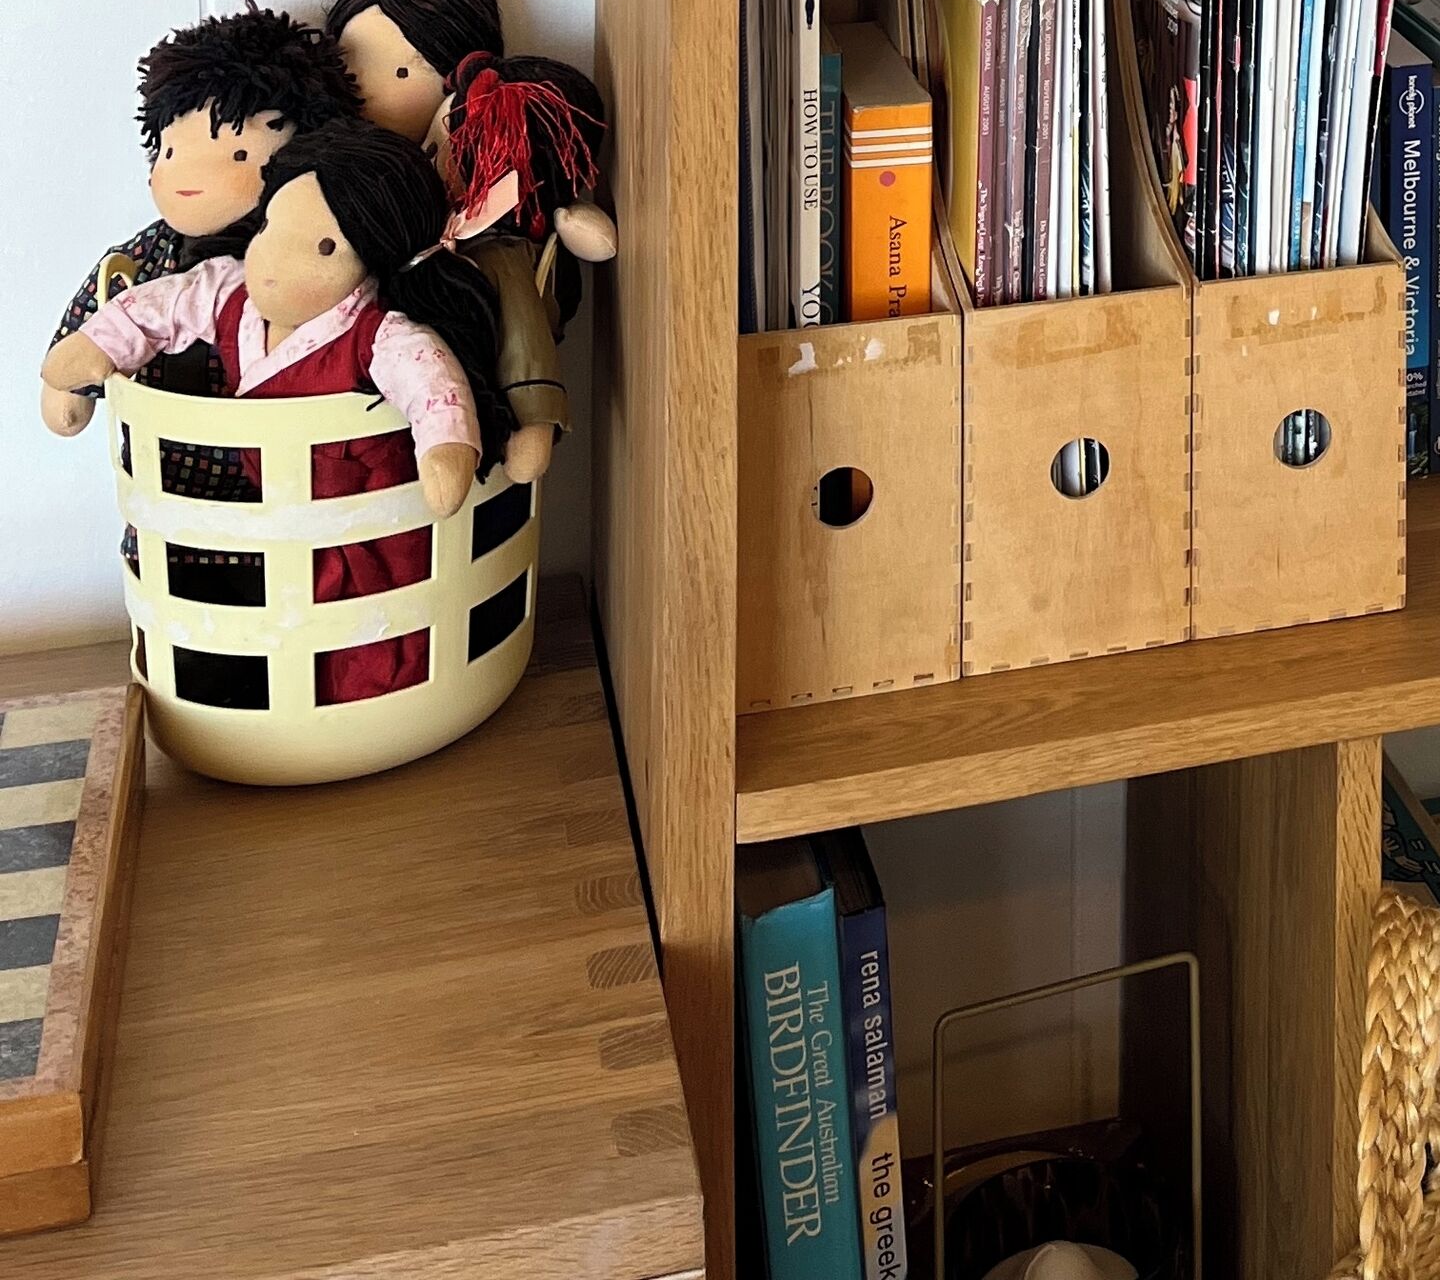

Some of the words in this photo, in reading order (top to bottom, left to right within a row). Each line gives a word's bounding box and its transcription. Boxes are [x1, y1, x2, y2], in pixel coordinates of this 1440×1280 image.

[984, 14, 993, 37] YOGA
[983, 38, 992, 72] JOURNAL
[982, 85, 990, 115] AUGUST
[1042, 80, 1050, 121] NOVEMBER
[1406, 74, 1418, 101] lonely
[803, 88, 819, 136] HOW
[1405, 101, 1417, 129] planet
[803, 140, 819, 169] TO
[803, 174, 819, 212] USE
[1403, 139, 1421, 250] Melbourne
[888, 214, 908, 278] Asana
[1404, 255, 1420, 271] &
[1405, 274, 1420, 356] Victoria
[860, 949, 885, 1009] rena
[805, 980, 830, 1025] The
[810, 1029, 834, 1089] Great
[863, 1015, 890, 1120] salaman
[763, 960, 823, 1248] BIRDFINDER
[815, 1098, 844, 1205] Australian
[870, 1151, 896, 1199] the
